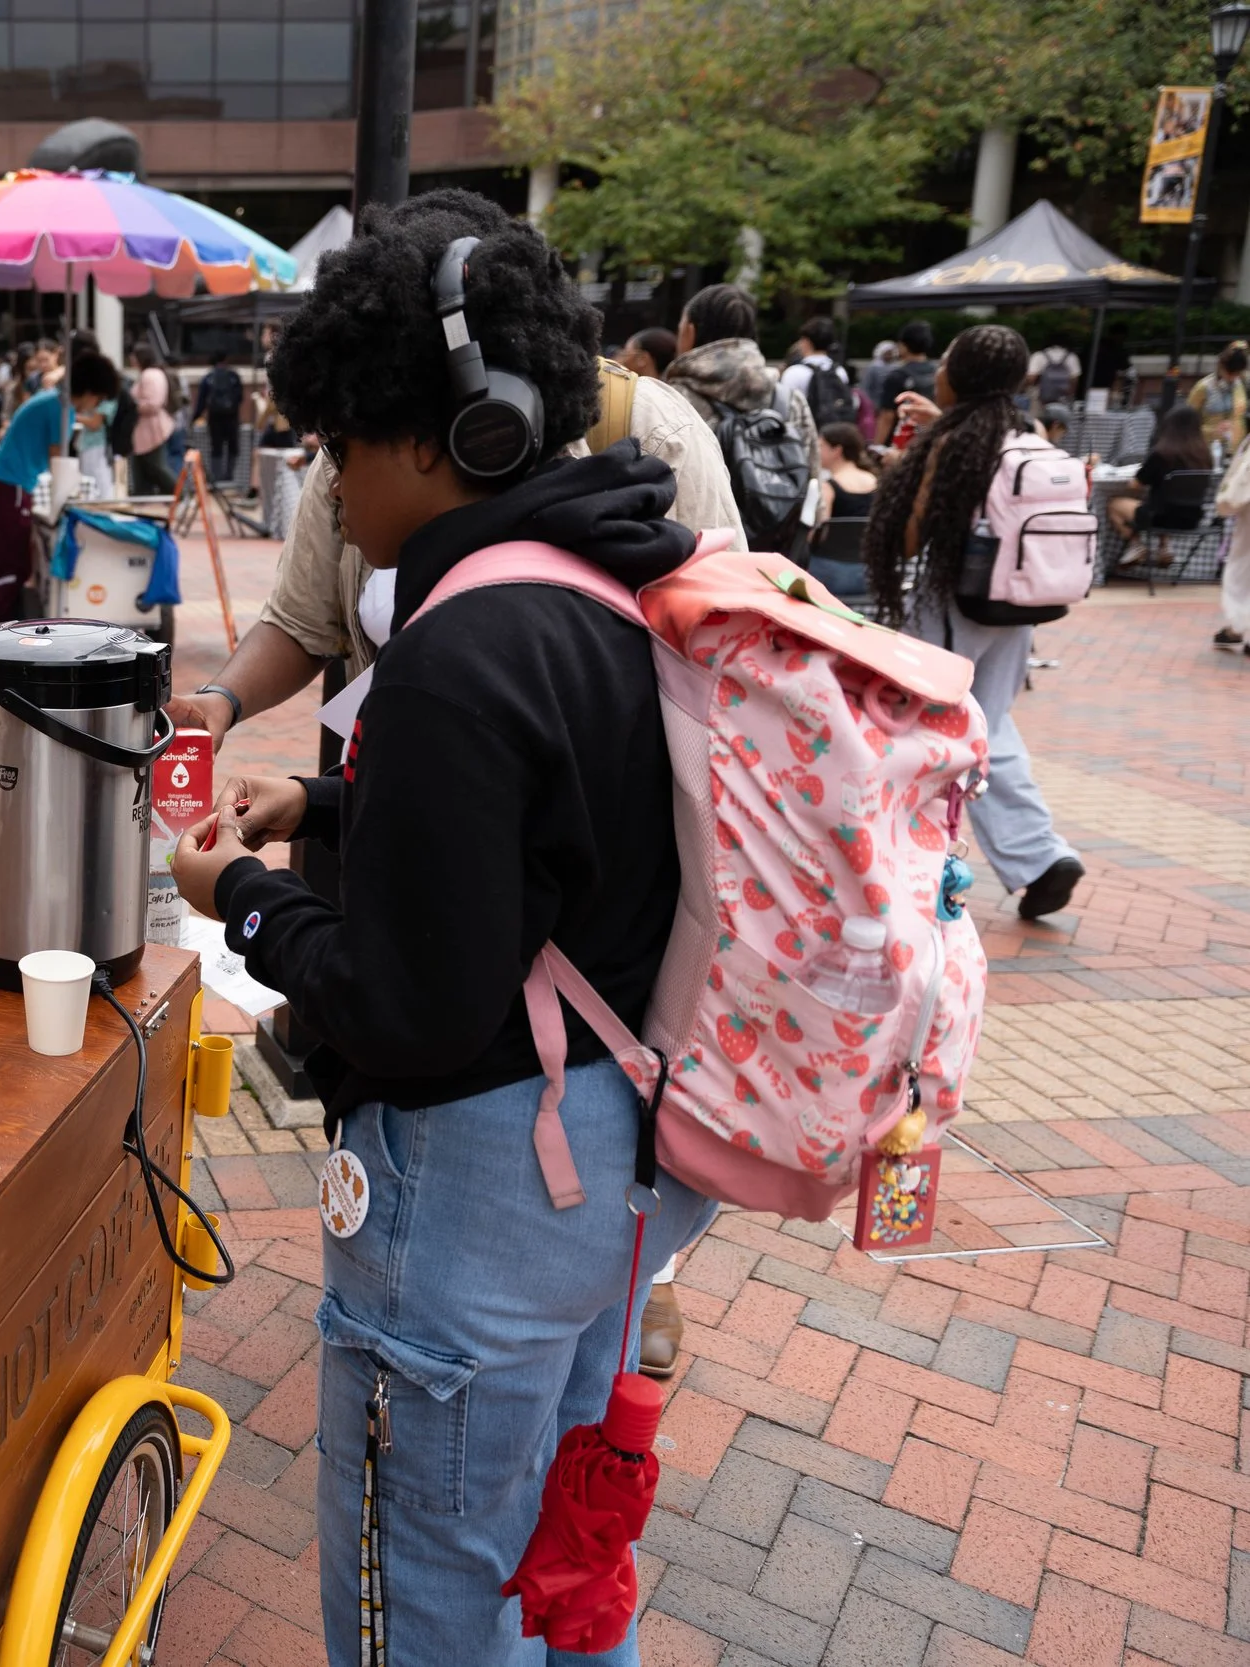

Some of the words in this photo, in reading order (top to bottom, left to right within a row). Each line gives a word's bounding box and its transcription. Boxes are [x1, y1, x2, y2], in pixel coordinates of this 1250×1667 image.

[161, 752, 199, 762] Schreiber
[157, 798, 179, 808] Leche
[180, 798, 203, 808] Entera
[61, 1121, 175, 1345] COFFEE
